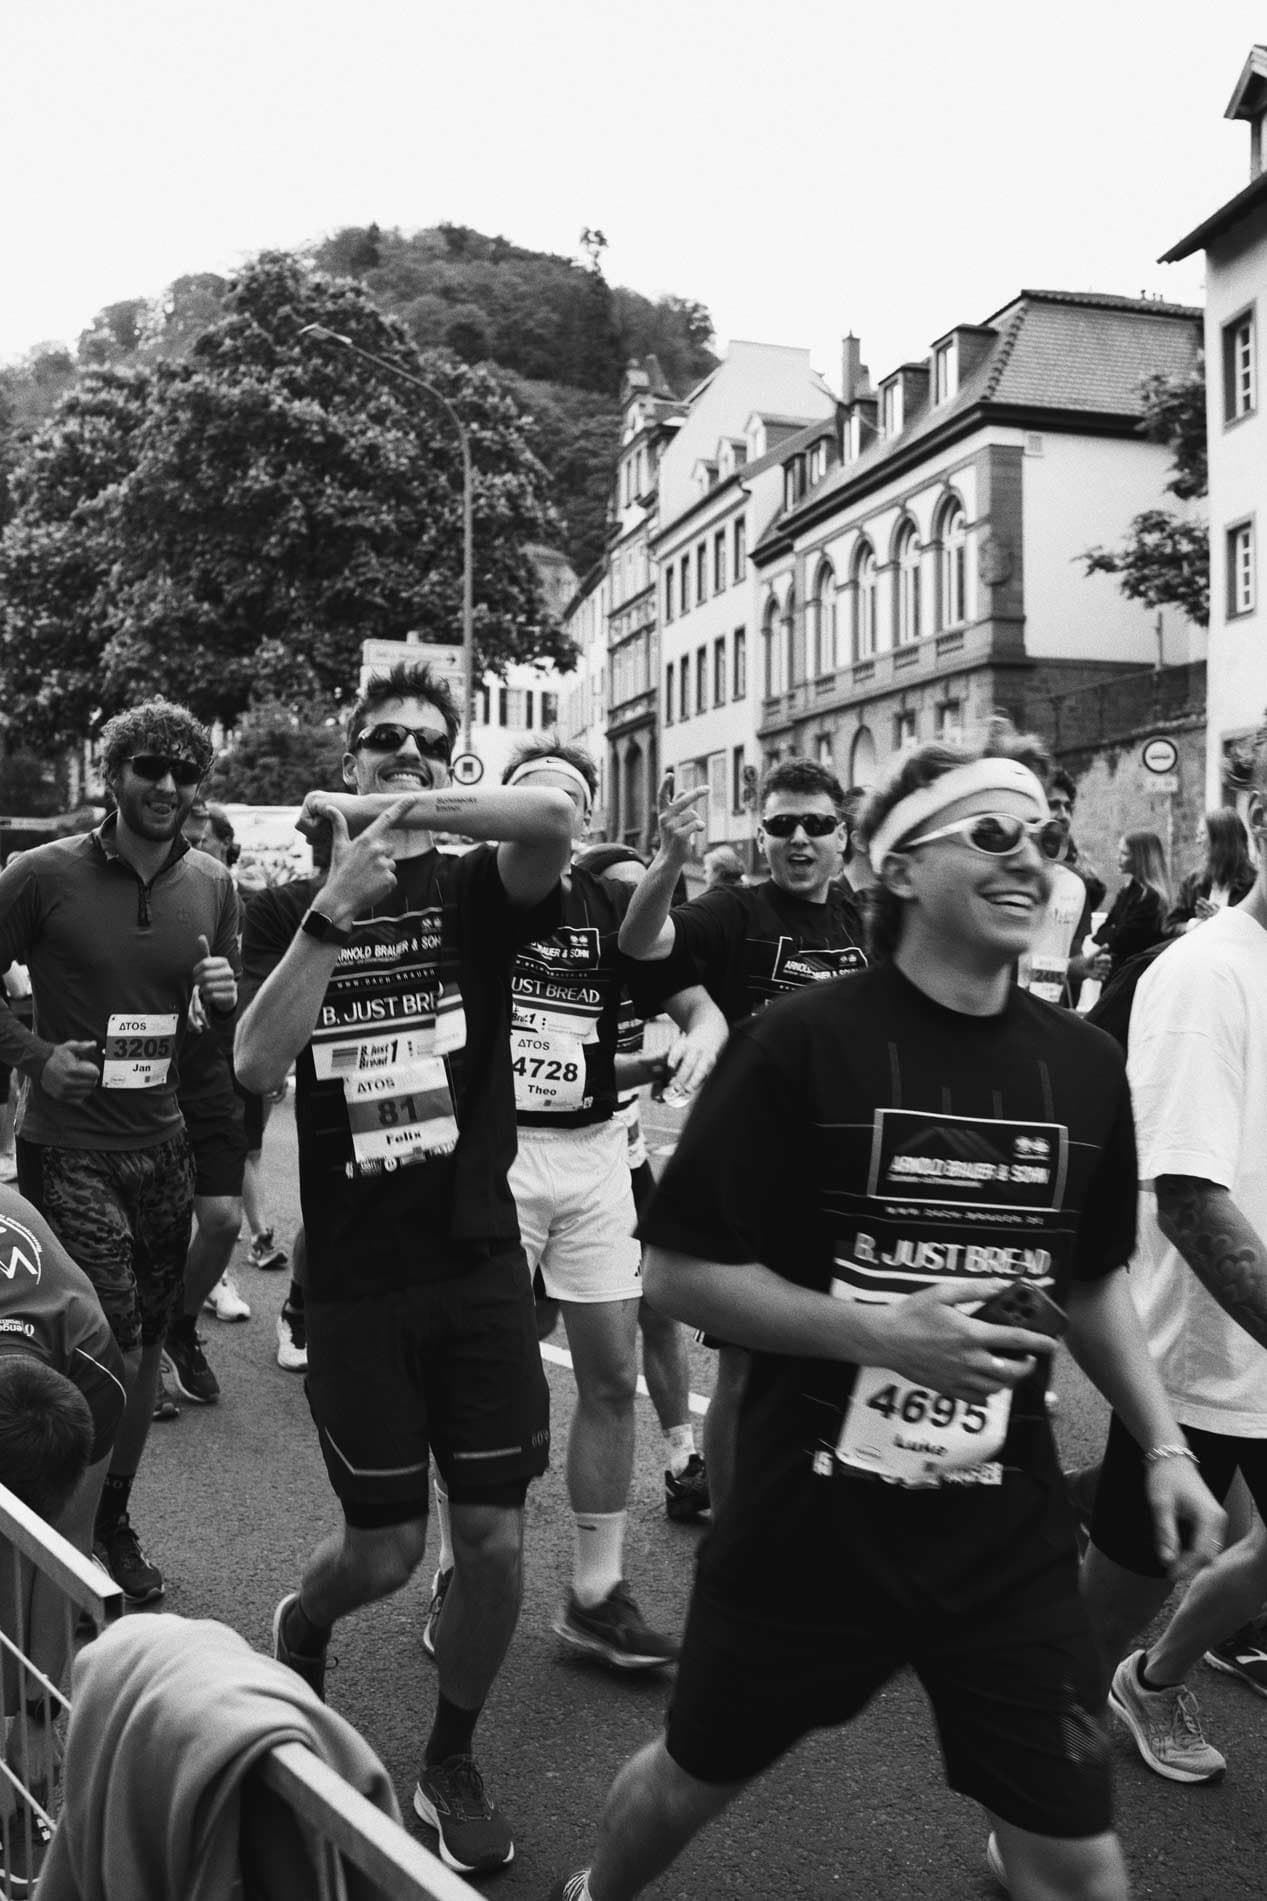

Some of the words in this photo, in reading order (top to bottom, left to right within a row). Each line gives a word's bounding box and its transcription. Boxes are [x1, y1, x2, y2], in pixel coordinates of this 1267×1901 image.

[511, 976, 546, 995] UST
[545, 983, 600, 1003] BREAD
[343, 997, 398, 1023] JUST
[119, 1022, 147, 1031] ATOS
[113, 1038, 169, 1058] 3205
[518, 1039, 550, 1051] ATOS
[132, 1064, 151, 1072] Jan
[513, 1056, 578, 1082] 4728
[357, 1077, 395, 1094] ATOS
[528, 1085, 557, 1096] Theo
[377, 1096, 418, 1127] 81
[386, 1131, 421, 1145] Felix
[881, 1239, 965, 1271] JUST
[964, 1245, 1052, 1275] BREAD
[866, 1383, 987, 1434] 4695
